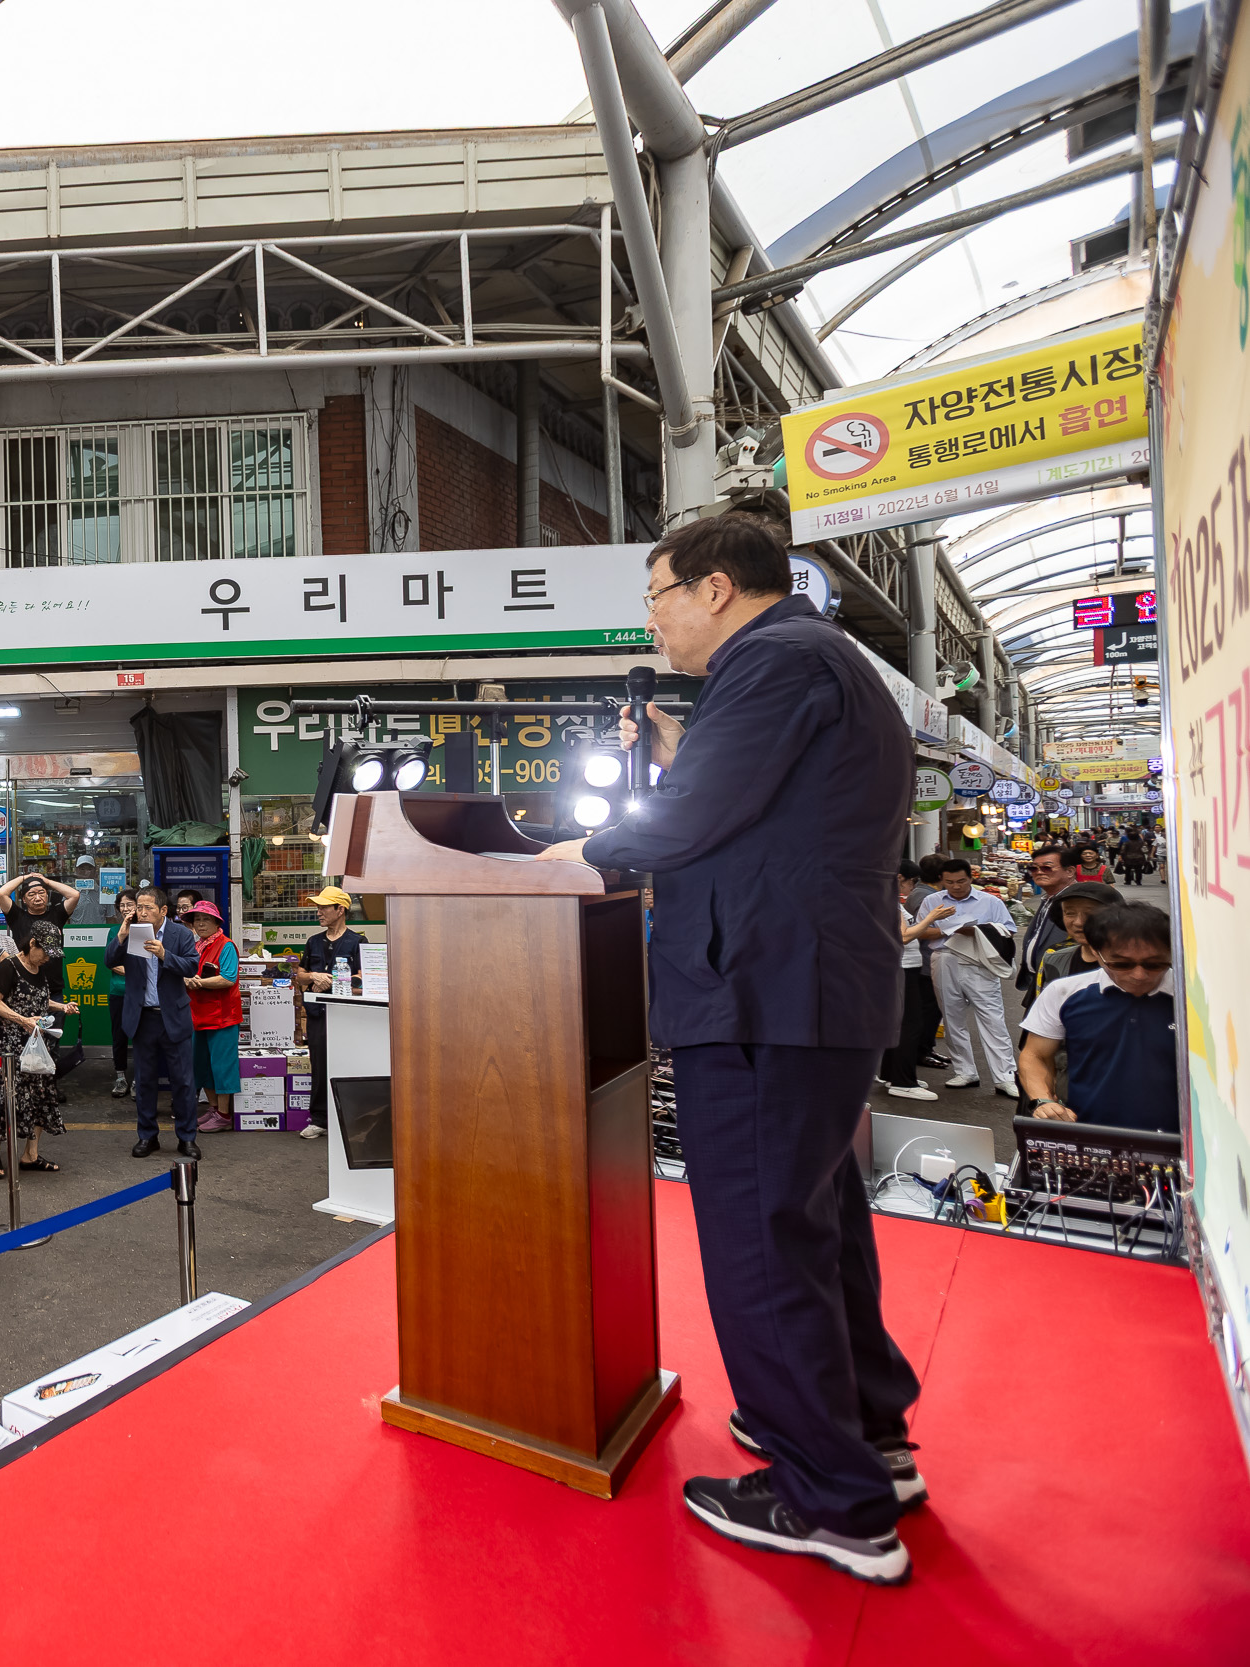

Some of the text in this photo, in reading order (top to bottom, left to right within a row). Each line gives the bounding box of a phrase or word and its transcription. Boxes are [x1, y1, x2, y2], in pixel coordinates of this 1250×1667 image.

[904, 344, 1143, 430] 자양전통시장
[907, 394, 1128, 470] 통행로에서 흡연
[806, 474, 897, 501] No Smoking Area
[1047, 450, 1150, 482] 계도기간 20
[823, 480, 999, 528] 지정일 2022년 6월 14일
[201, 568, 555, 630] 우리마트
[1177, 485, 1225, 684] 2025
[604, 631, 654, 643] T.444-0
[996, 789, 1012, 797] 상회
[1192, 818, 1208, 899] 맞이
[1035, 1141, 1112, 1155] MIDAS M32R
